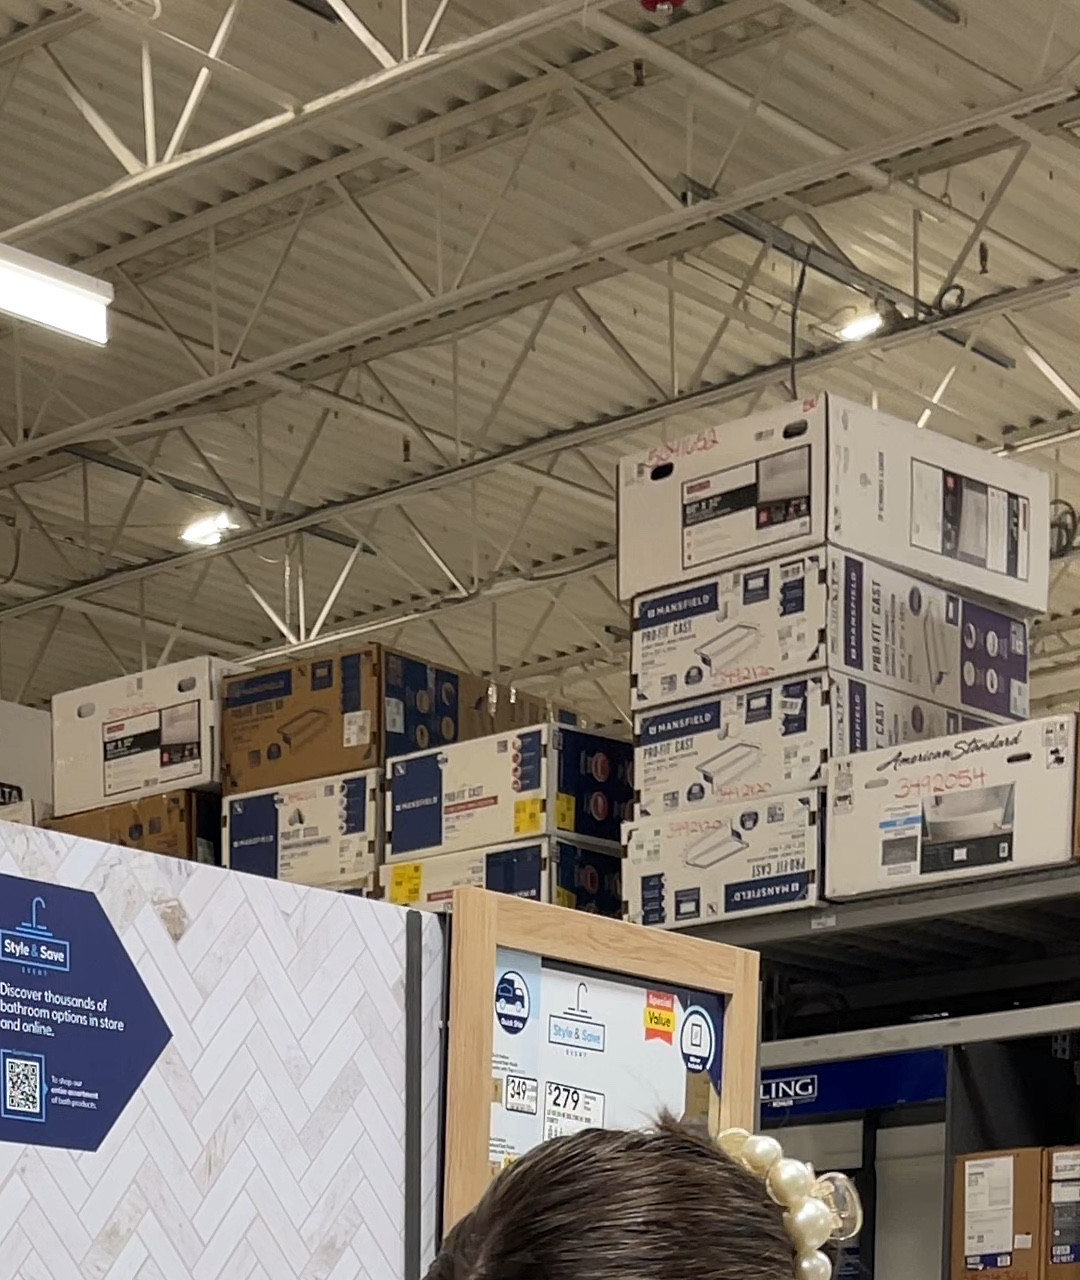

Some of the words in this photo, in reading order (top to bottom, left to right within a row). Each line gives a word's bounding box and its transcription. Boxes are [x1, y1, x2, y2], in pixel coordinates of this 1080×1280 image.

[657, 594, 710, 615] MANSFIELD
[673, 620, 692, 635] CAST
[658, 713, 711, 733] MANSFIELD
[675, 738, 695, 753] CAST
[876, 750, 951, 772] American
[950, 730, 1022, 761] Standard
[732, 885, 789, 901] MANSFIELD
[4, 939, 30, 957] Style
[31, 944, 39, 957] &
[40, 946, 65, 962] Save
[0, 982, 42, 1001] Discover
[44, 990, 95, 1011] thousands
[97, 998, 108, 1011] of
[0, 999, 50, 1019] bathroom
[51, 1009, 87, 1026] options
[89, 1013, 98, 1026] in
[100, 1016, 124, 1031] store
[648, 1011, 672, 1028] Value
[0, 1017, 20, 1032] and
[21, 1020, 55, 1037] online.
[553, 1024, 573, 1040] Style
[574, 1028, 581, 1039] &
[582, 1030, 601, 1045] Save
